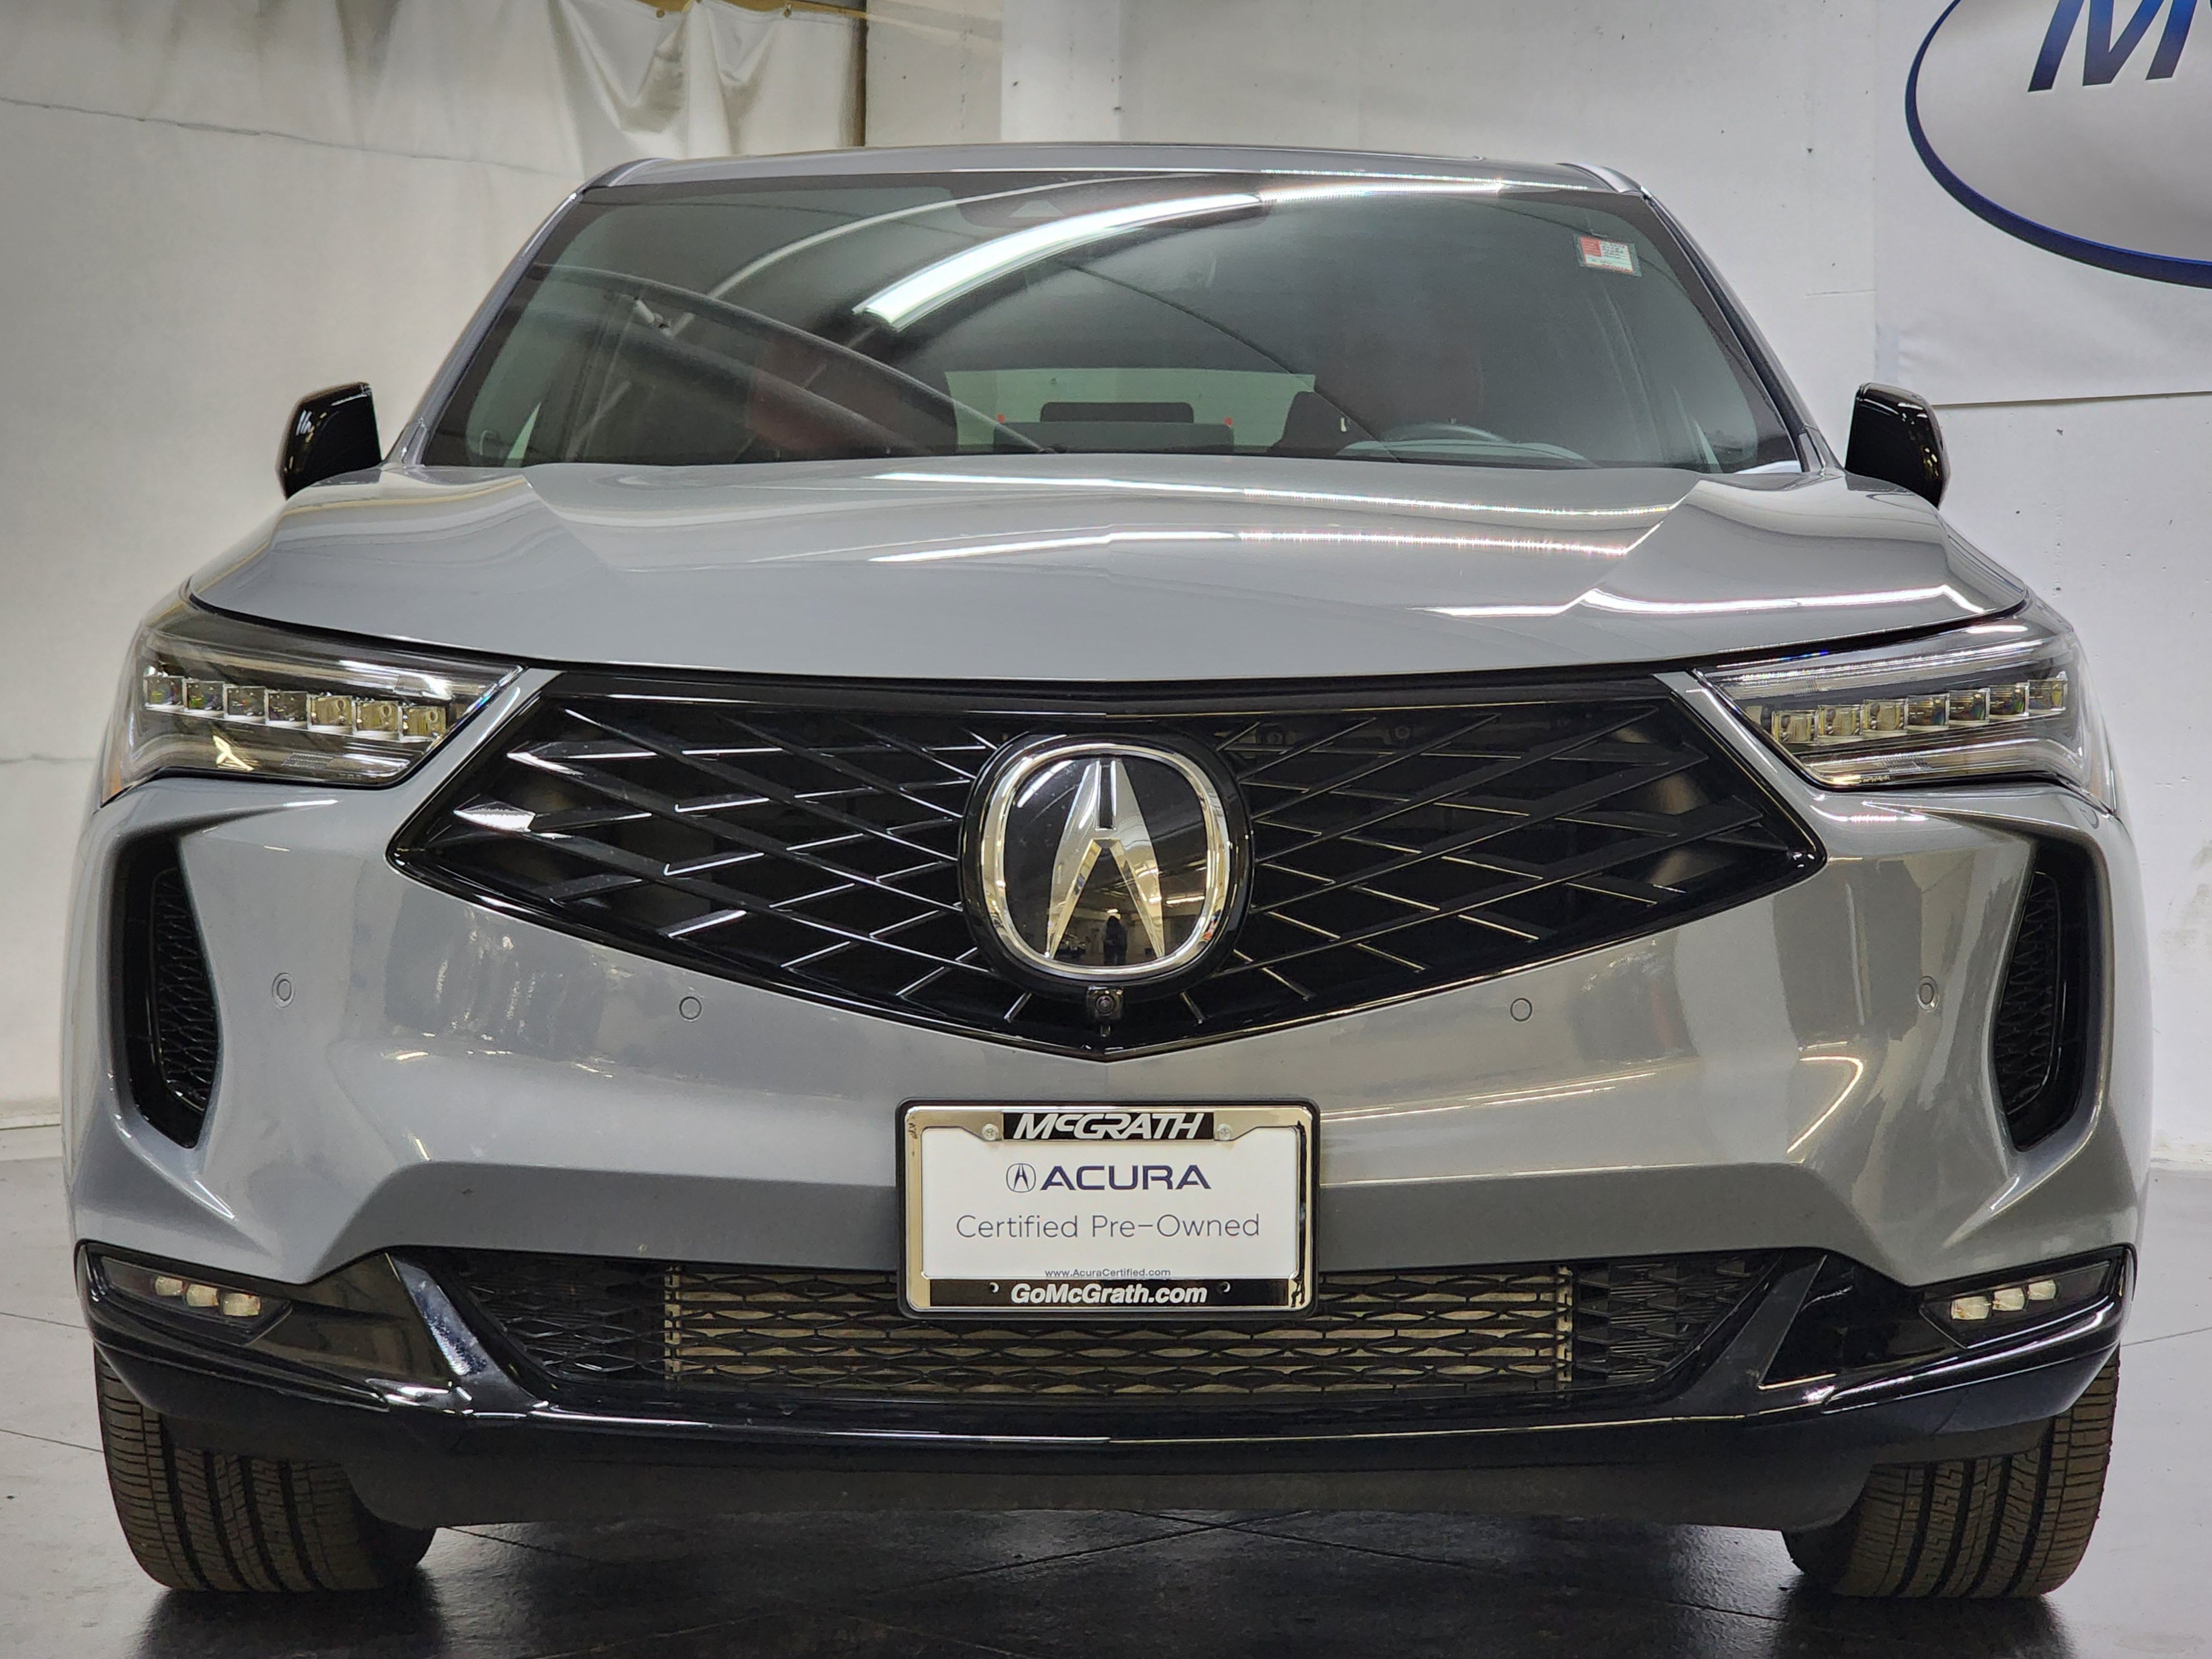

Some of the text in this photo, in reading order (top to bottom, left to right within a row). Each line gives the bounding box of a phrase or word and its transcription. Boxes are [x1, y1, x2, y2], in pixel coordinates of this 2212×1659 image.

[2027, 0, 2212, 92] M
[1040, 1165, 1212, 1190] ACURA
[956, 1213, 1260, 1238] Certified Pre-Owned
[1045, 1268, 1171, 1277] www.AcuraCertified.com
[1011, 1283, 1208, 1304] GoMcGrath.com
